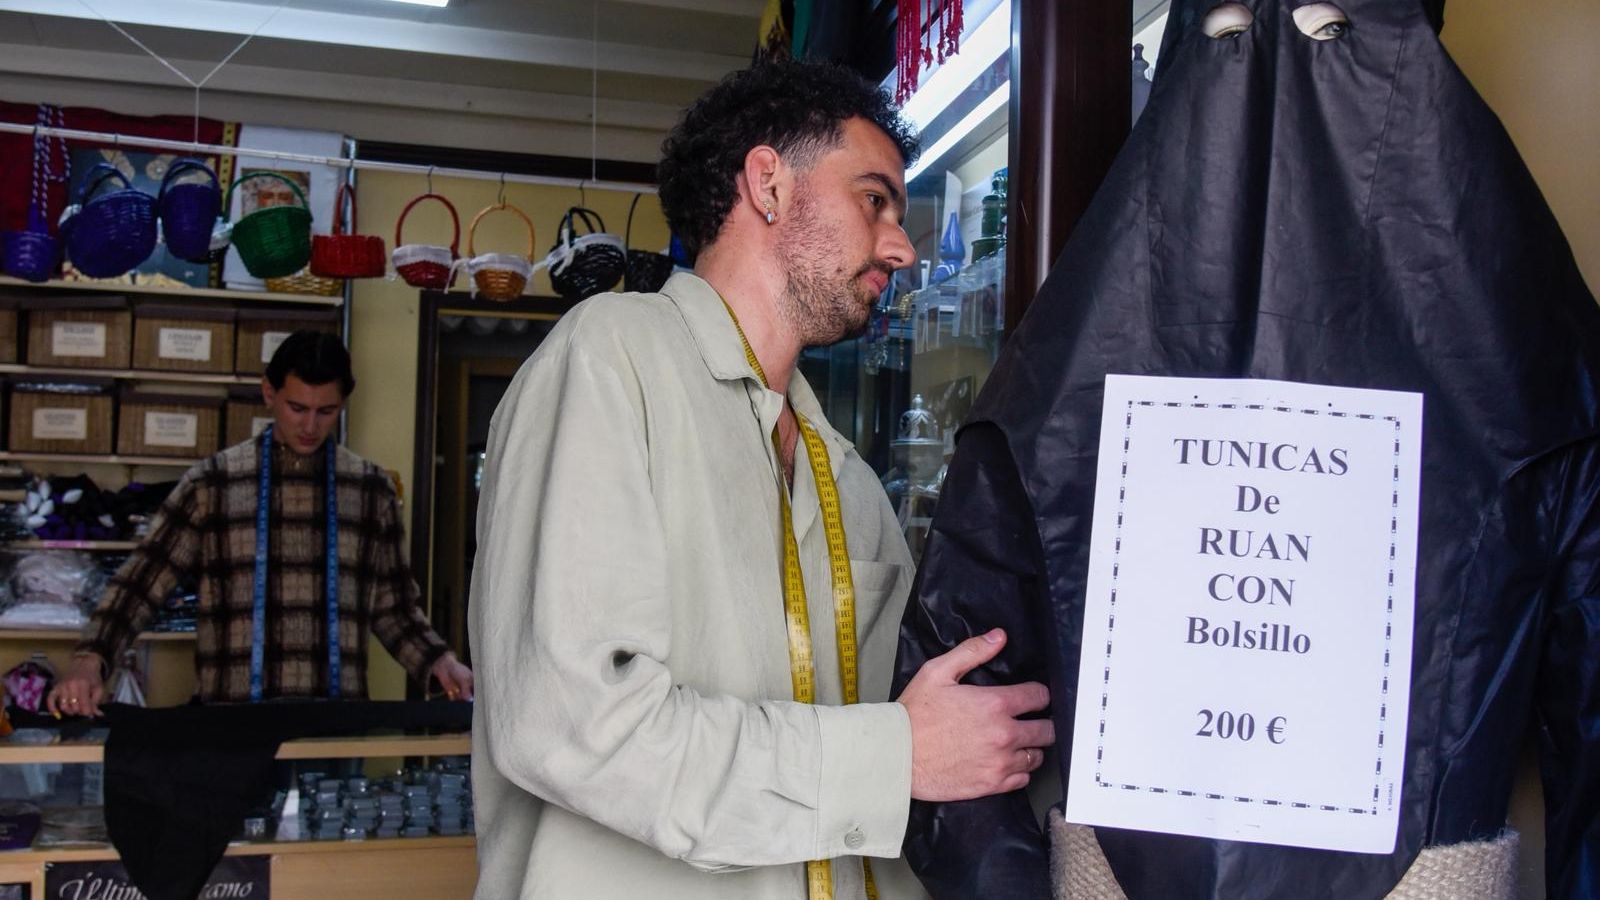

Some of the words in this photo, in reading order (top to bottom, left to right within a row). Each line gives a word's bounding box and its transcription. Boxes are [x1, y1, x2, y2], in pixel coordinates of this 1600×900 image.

[1173, 438, 1349, 476] TUNICAS
[1236, 485, 1281, 515] De
[1199, 527, 1311, 562] RUAN
[1208, 573, 1295, 606] CON
[1186, 616, 1312, 655] Bolsillo
[1196, 709, 1255, 741] 200
[1266, 716, 1288, 745] €
